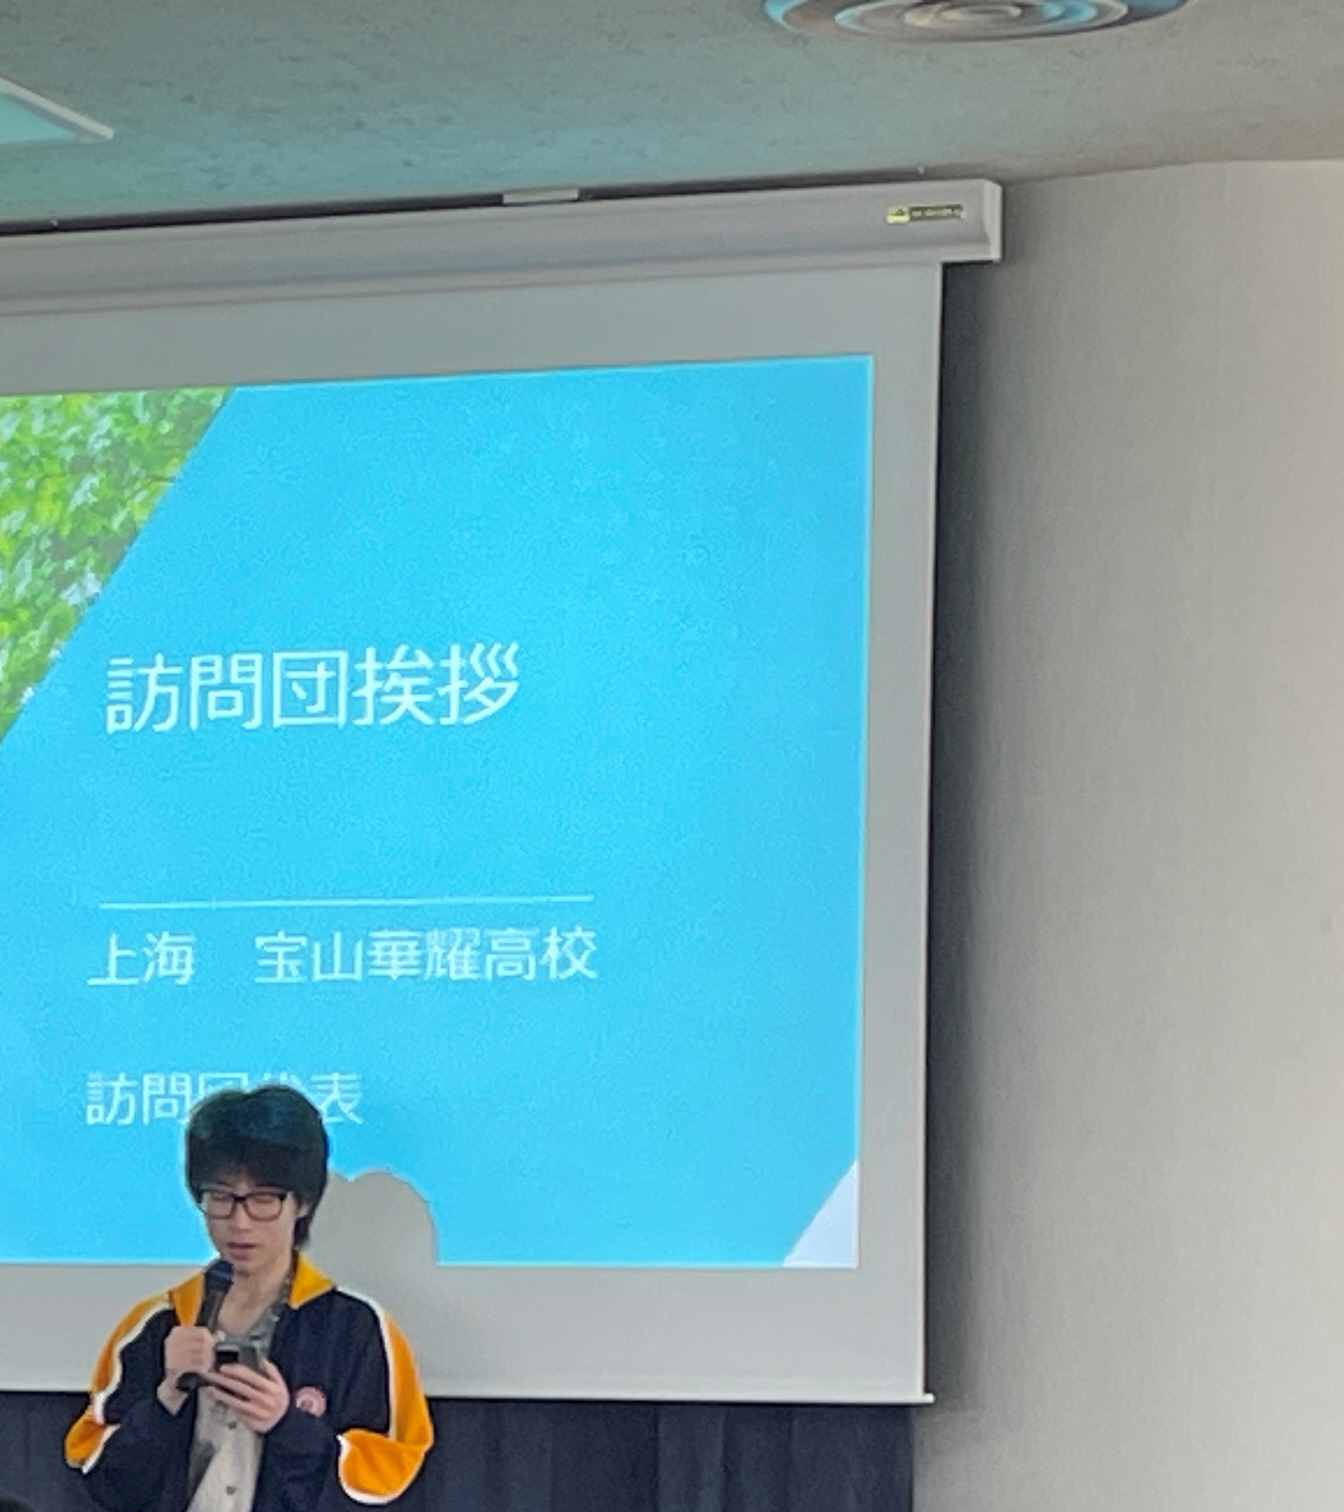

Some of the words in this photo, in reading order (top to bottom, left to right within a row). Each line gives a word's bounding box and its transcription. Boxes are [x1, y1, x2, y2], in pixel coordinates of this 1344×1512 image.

[105, 641, 521, 734] 訪問団挨拶
[86, 931, 196, 987] 上海
[254, 925, 598, 983] 宝山華耀高校
[85, 1072, 365, 1127] 訪問表
